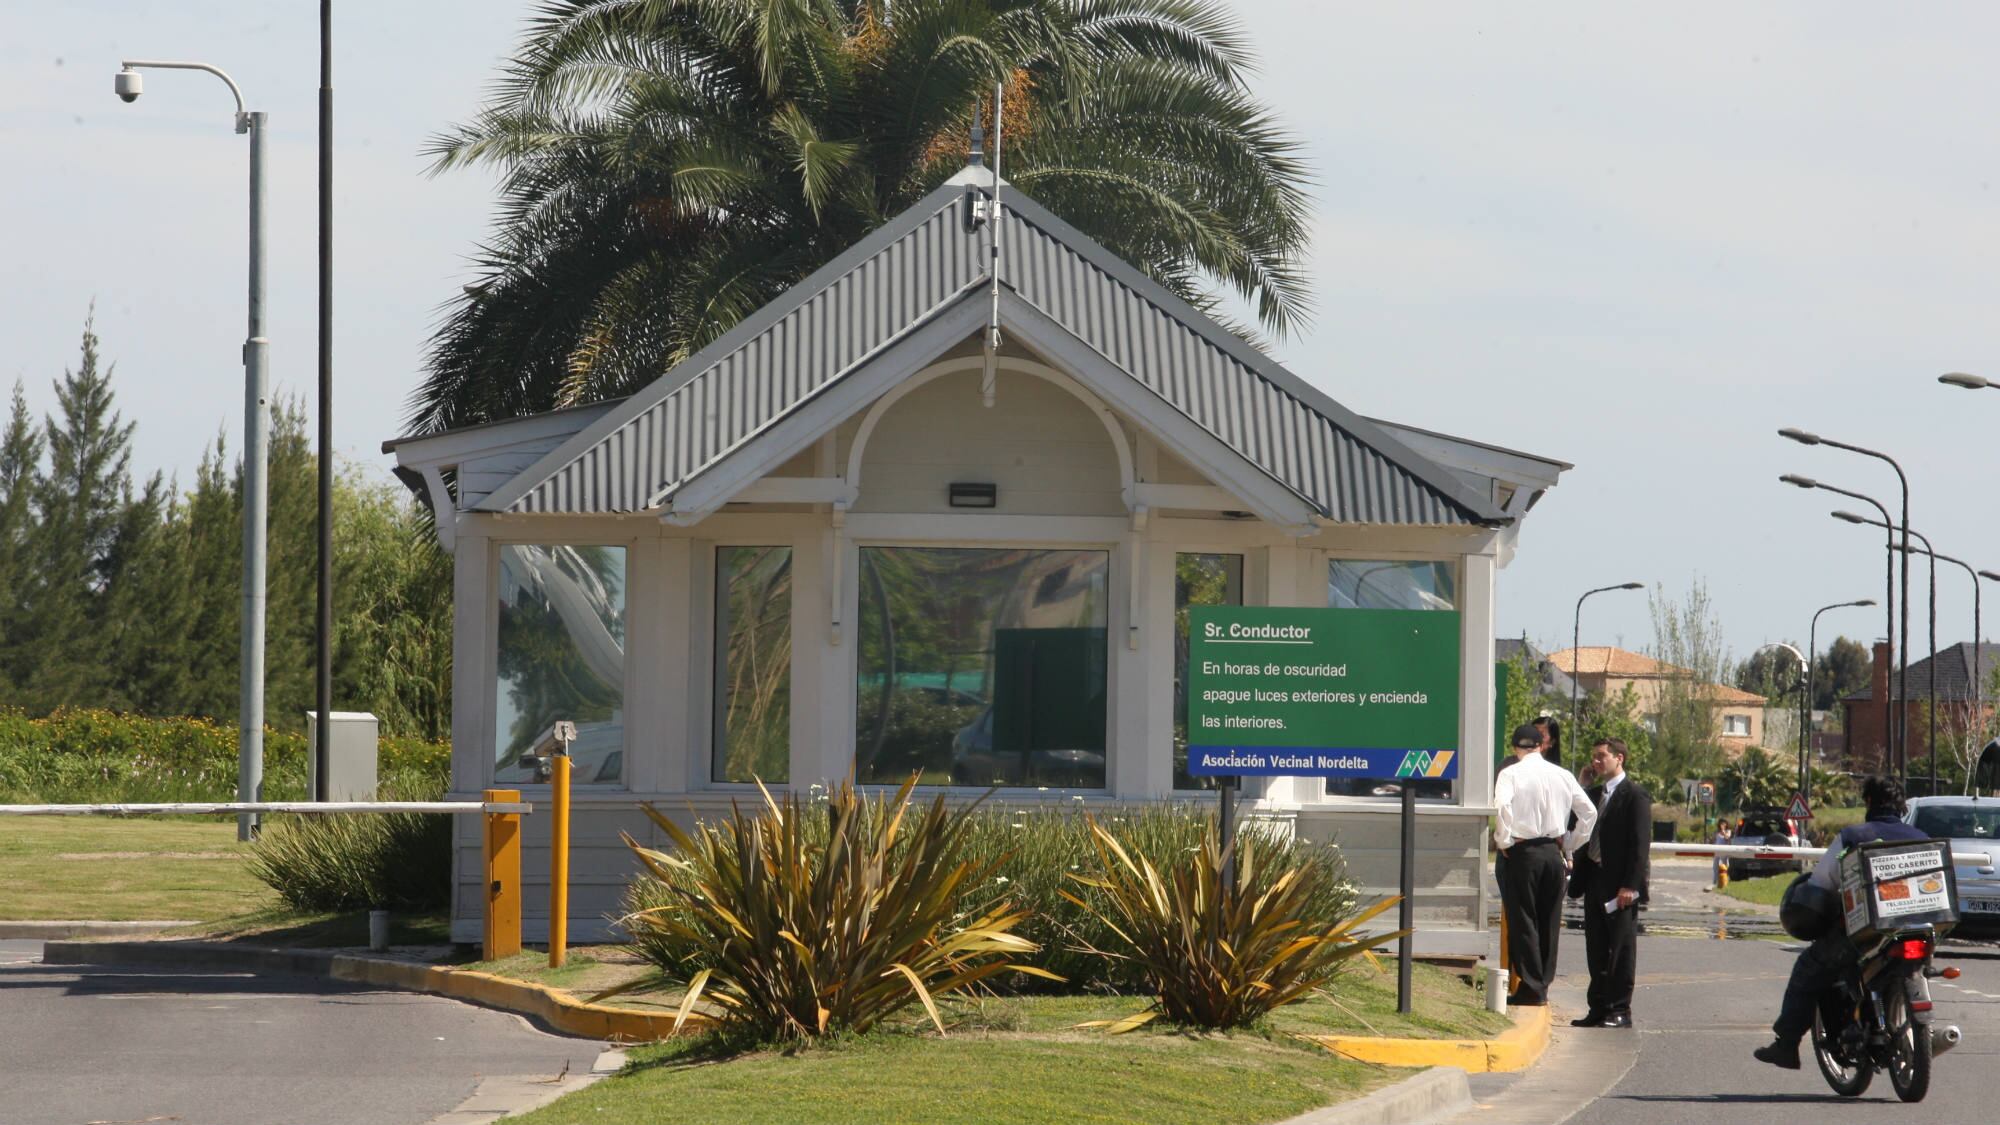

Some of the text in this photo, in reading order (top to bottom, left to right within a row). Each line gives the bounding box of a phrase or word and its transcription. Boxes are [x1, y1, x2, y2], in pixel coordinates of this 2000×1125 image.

[1204, 623, 1311, 639] Sr. Conductor
[1203, 662, 1346, 677] En horas de oscuridad
[1203, 688, 1428, 706] apague luces exteriores y encienda
[1202, 715, 1287, 729] las interiores.
[1202, 754, 1369, 770] Asociación Vecinal Nordelta
[1874, 859, 1938, 871] TODO CASERITO
